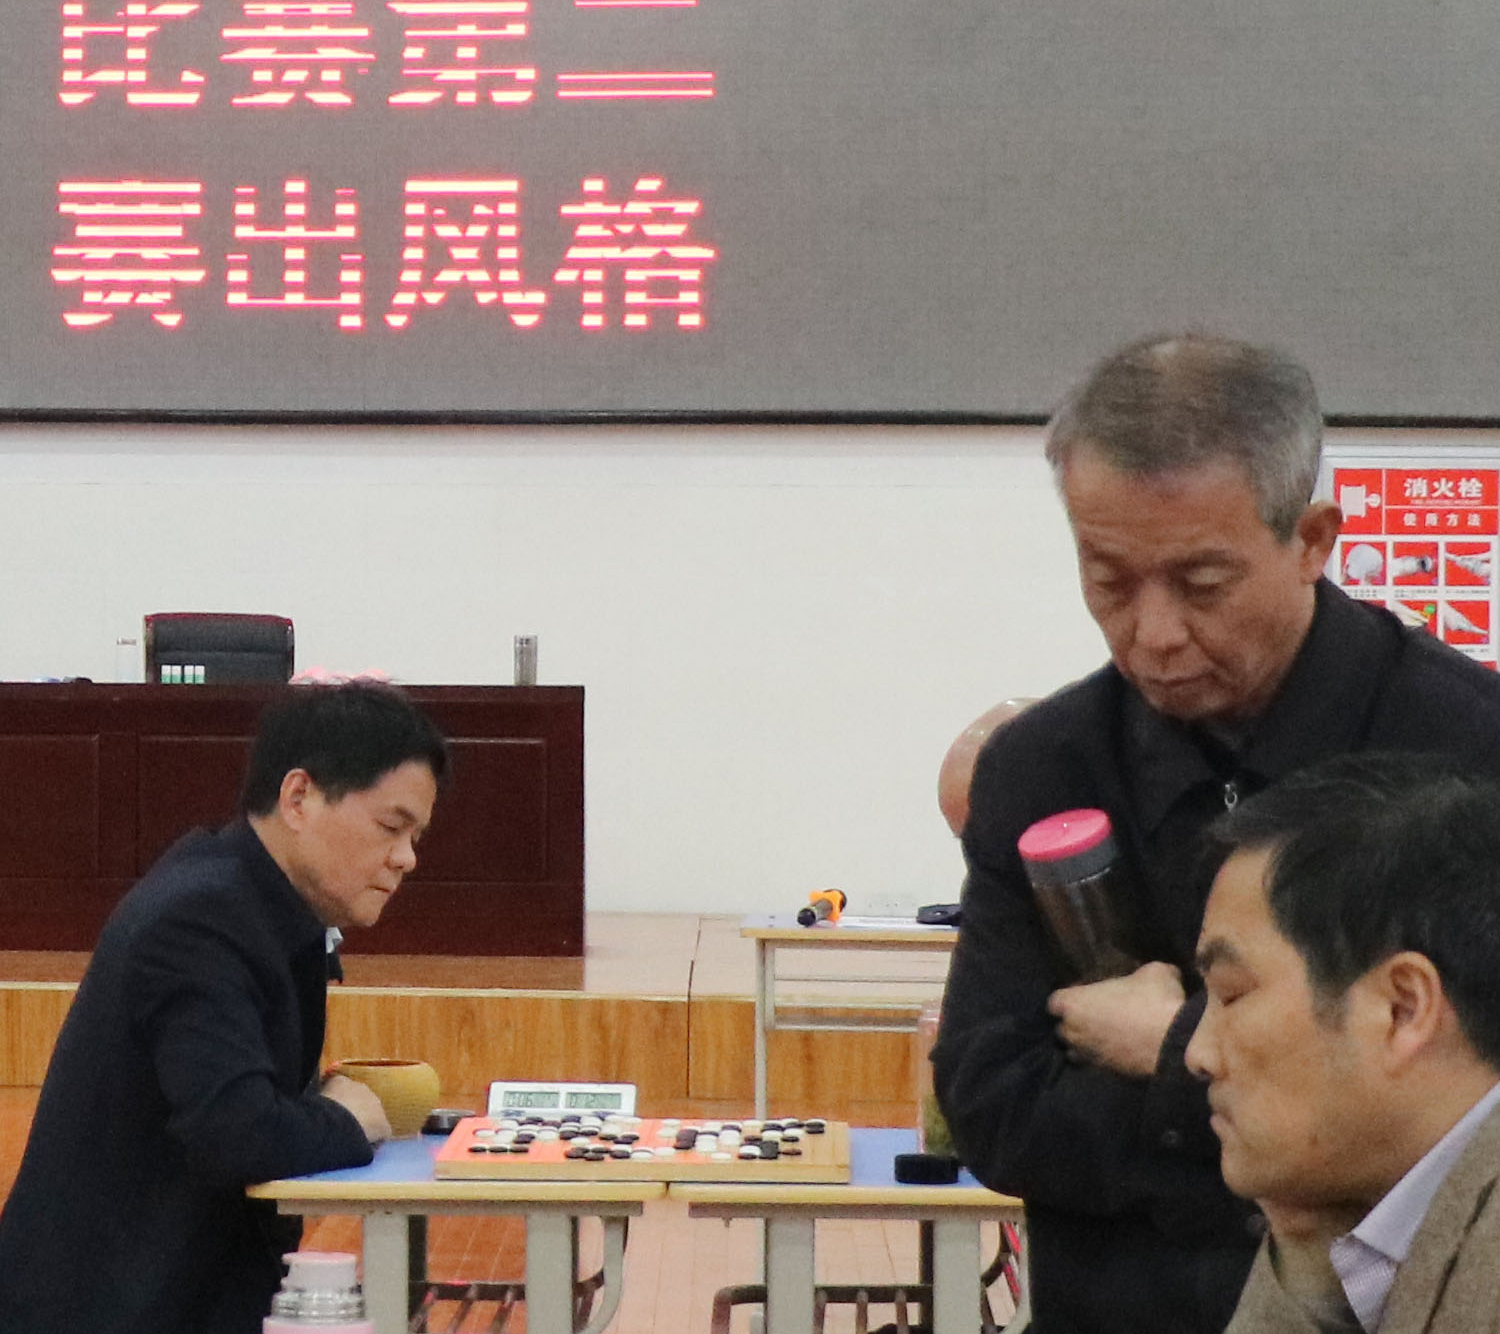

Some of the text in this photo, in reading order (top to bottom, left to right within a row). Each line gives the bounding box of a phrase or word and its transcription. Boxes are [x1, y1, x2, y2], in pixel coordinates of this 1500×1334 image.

[50, 175, 717, 331] 赛出风格
[1403, 477, 1484, 498] 消火栓
